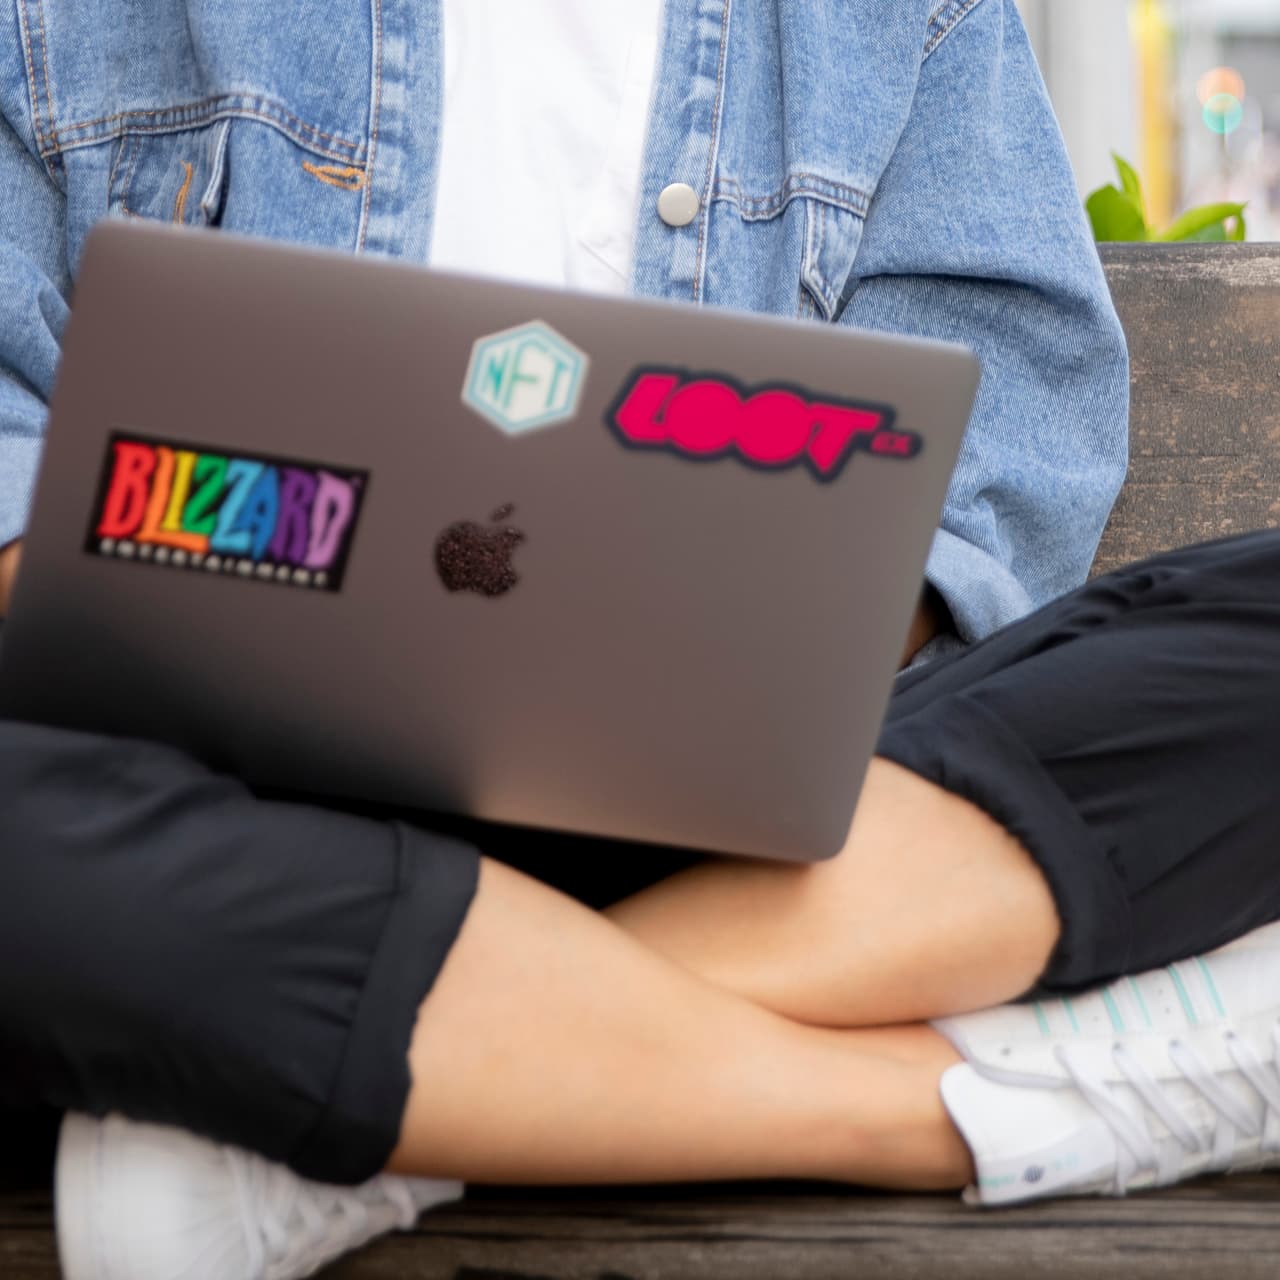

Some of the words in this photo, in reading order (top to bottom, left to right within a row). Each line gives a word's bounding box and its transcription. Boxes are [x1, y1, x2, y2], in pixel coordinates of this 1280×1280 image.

[482, 339, 569, 410] NFT
[616, 373, 884, 474] LOOT
[96, 439, 355, 569] BLIZZARD
